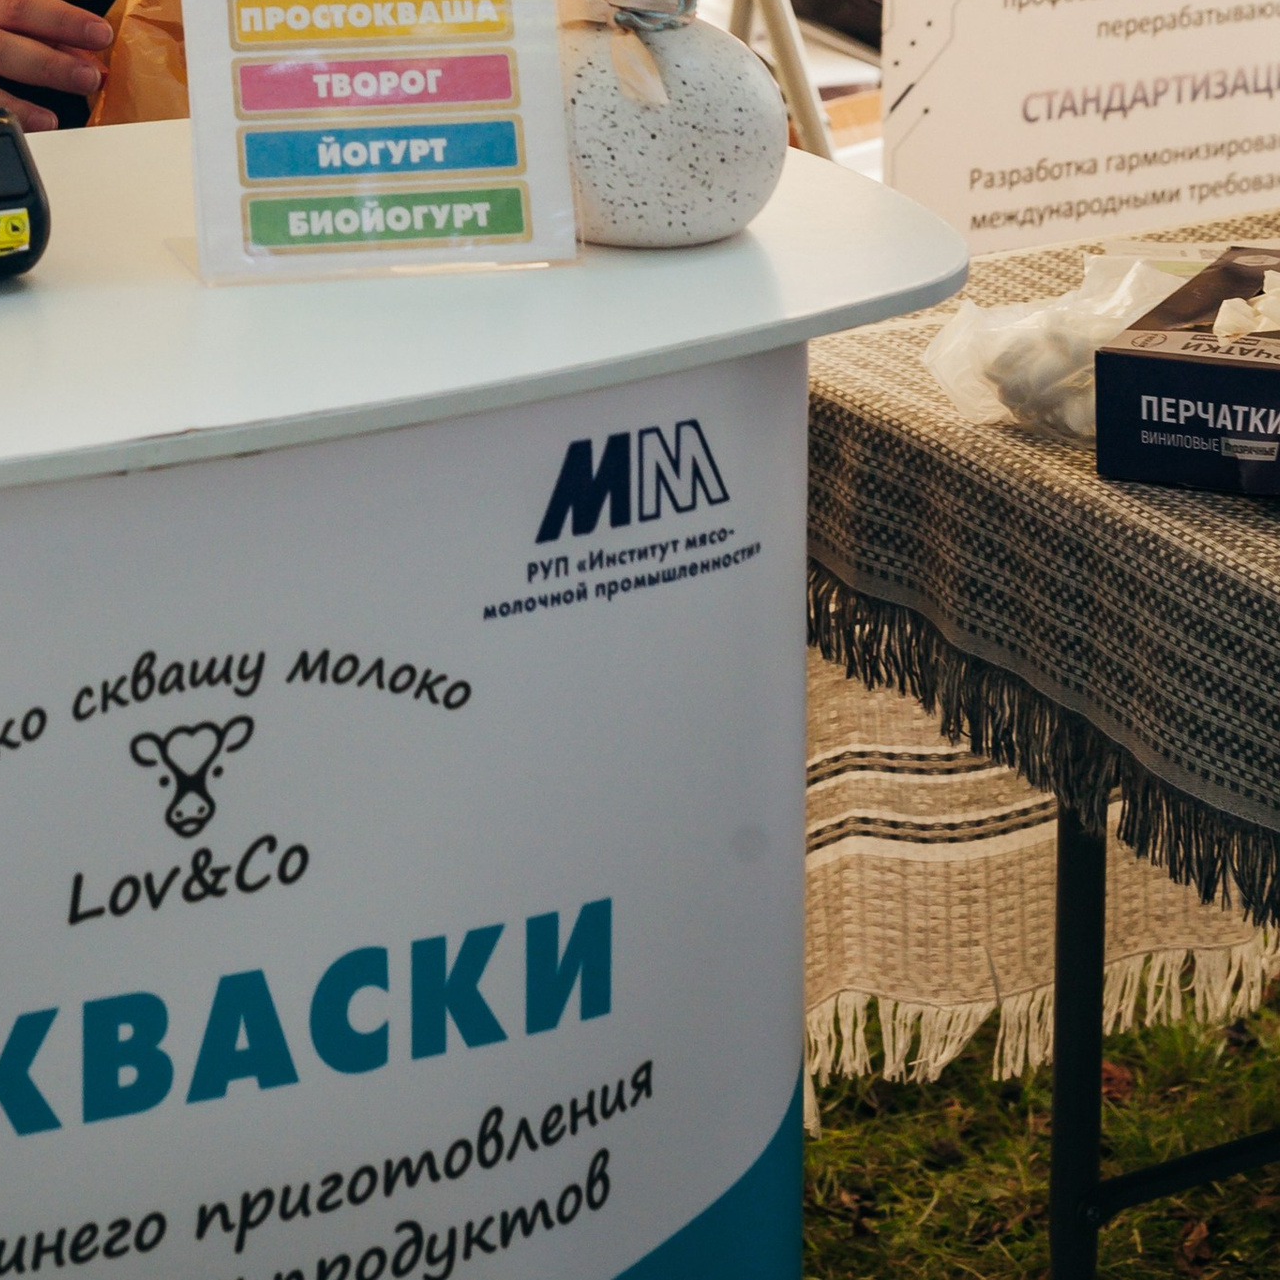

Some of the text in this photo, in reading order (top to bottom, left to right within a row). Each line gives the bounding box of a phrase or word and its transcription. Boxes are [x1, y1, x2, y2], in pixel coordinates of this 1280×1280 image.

[312, 69, 443, 100] ТВОРОГ
[1022, 62, 1280, 124] СТАНДАРТИЗАЦ
[317, 136, 448, 169] ЙОГУРТ
[969, 157, 1099, 191] Разработка
[288, 202, 491, 237] БИОЙОГУРТ
[970, 187, 1181, 231] международными
[1140, 394, 1280, 436] ПЕРЧАТКИ
[1140, 429, 1220, 453] ВИНИЛОВЫЕ
[526, 526, 735, 584] РУП «Институт мясо-
[482, 541, 762, 621] молочной промышленности»
[71, 649, 267, 722] сквашу
[286, 648, 473, 712] молоко
[67, 833, 310, 926] Lov&Co
[195, 1059, 656, 1254] приготовления
